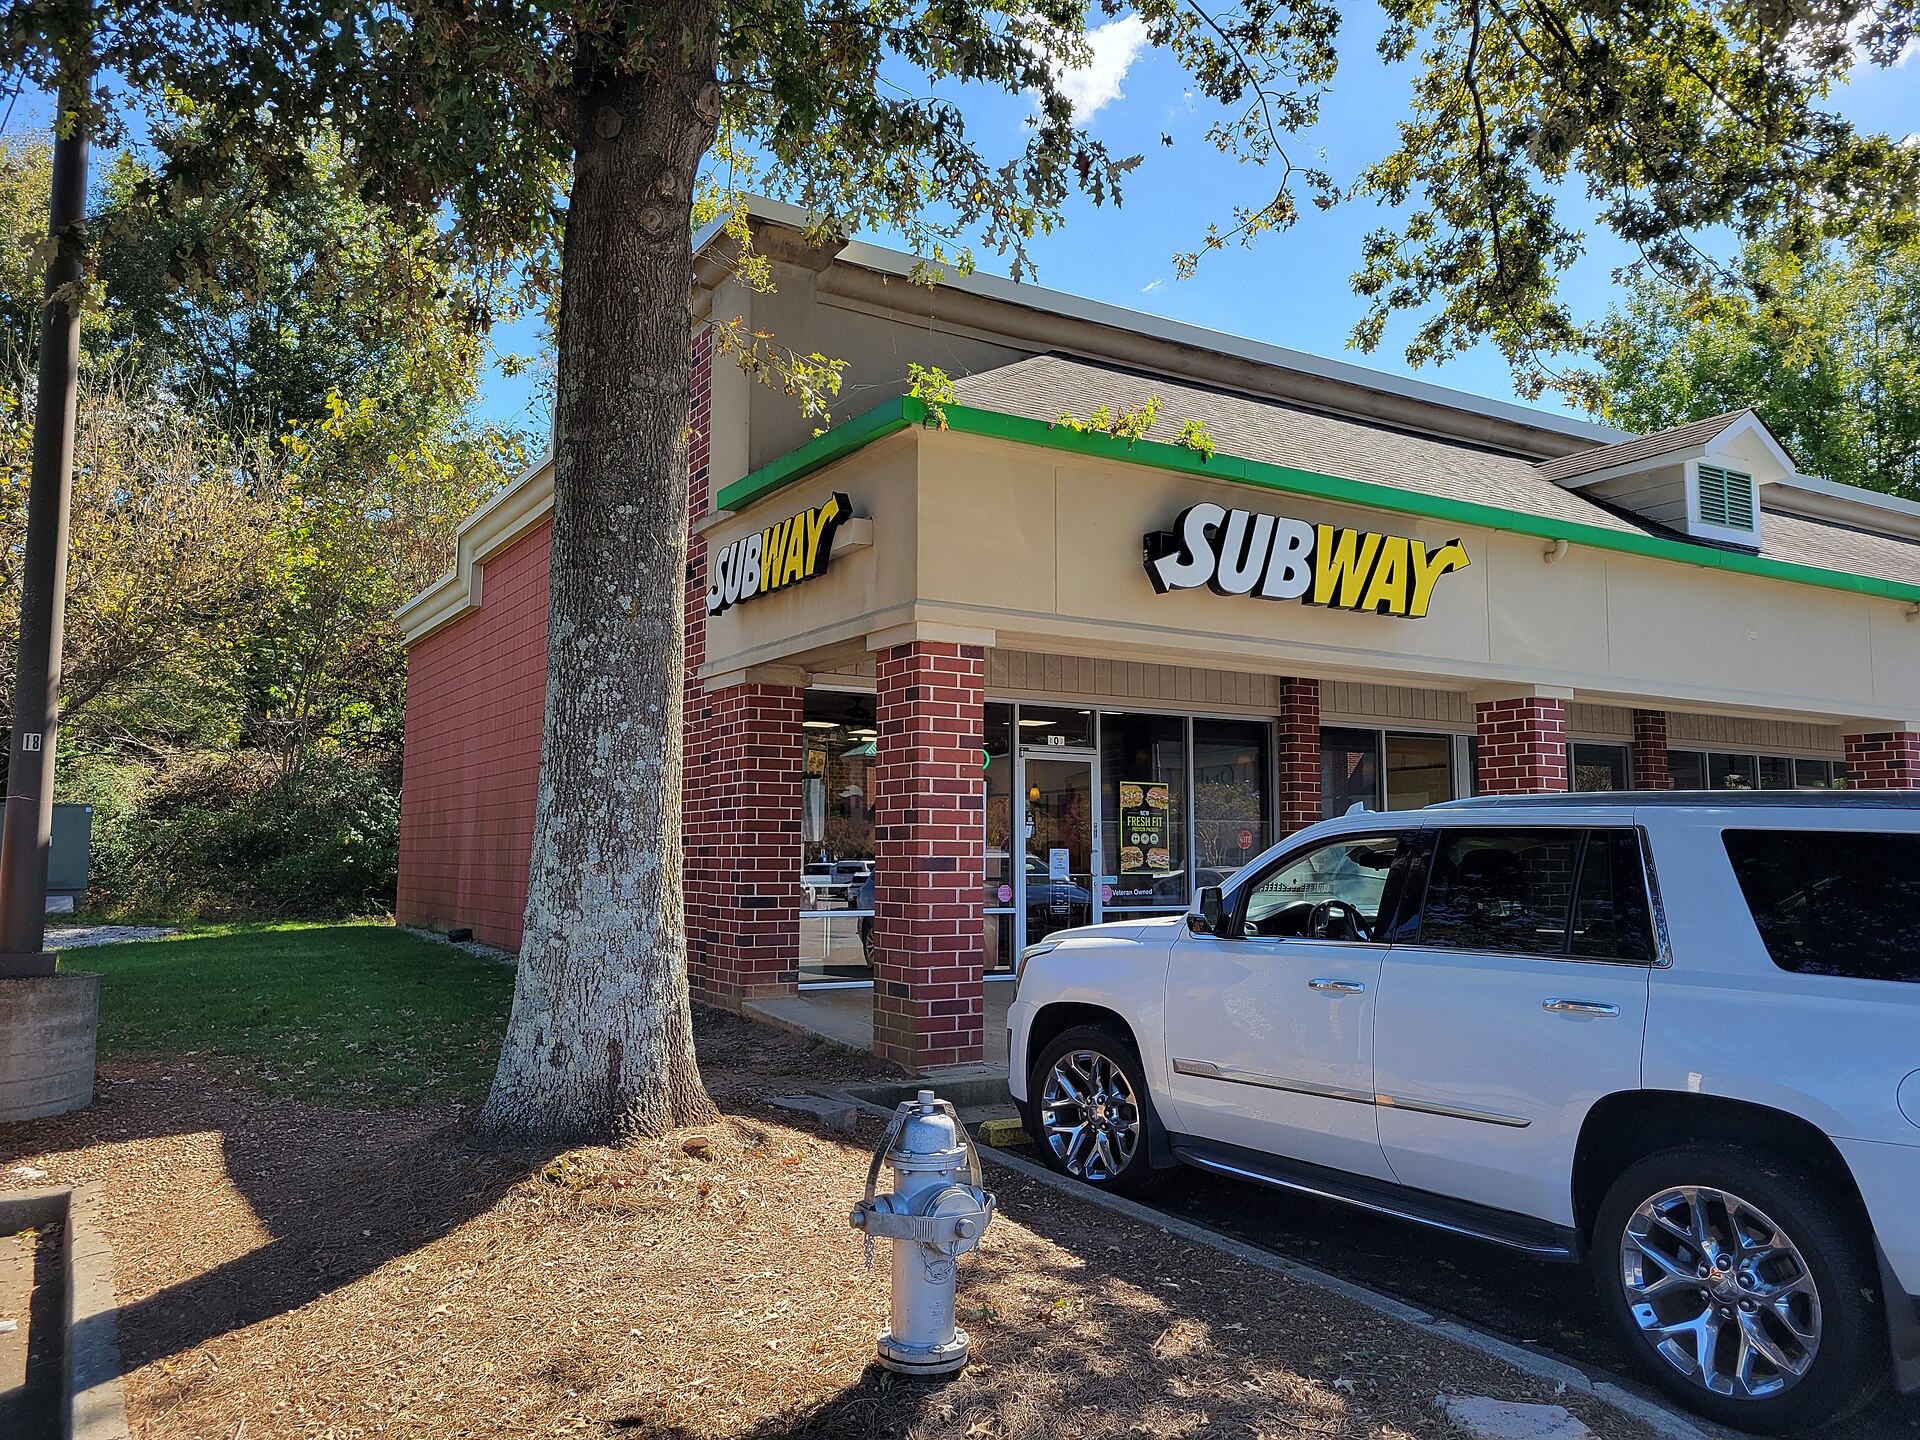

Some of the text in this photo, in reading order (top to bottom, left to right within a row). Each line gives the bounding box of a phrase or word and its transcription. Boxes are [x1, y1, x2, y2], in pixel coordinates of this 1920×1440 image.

[706, 494, 842, 613] SUBWAY
[1152, 502, 1471, 618] SUBWAY
[25, 734, 40, 750] 18
[1127, 816, 1163, 827] FRESH FIT
[1133, 888, 1153, 896] Owned
